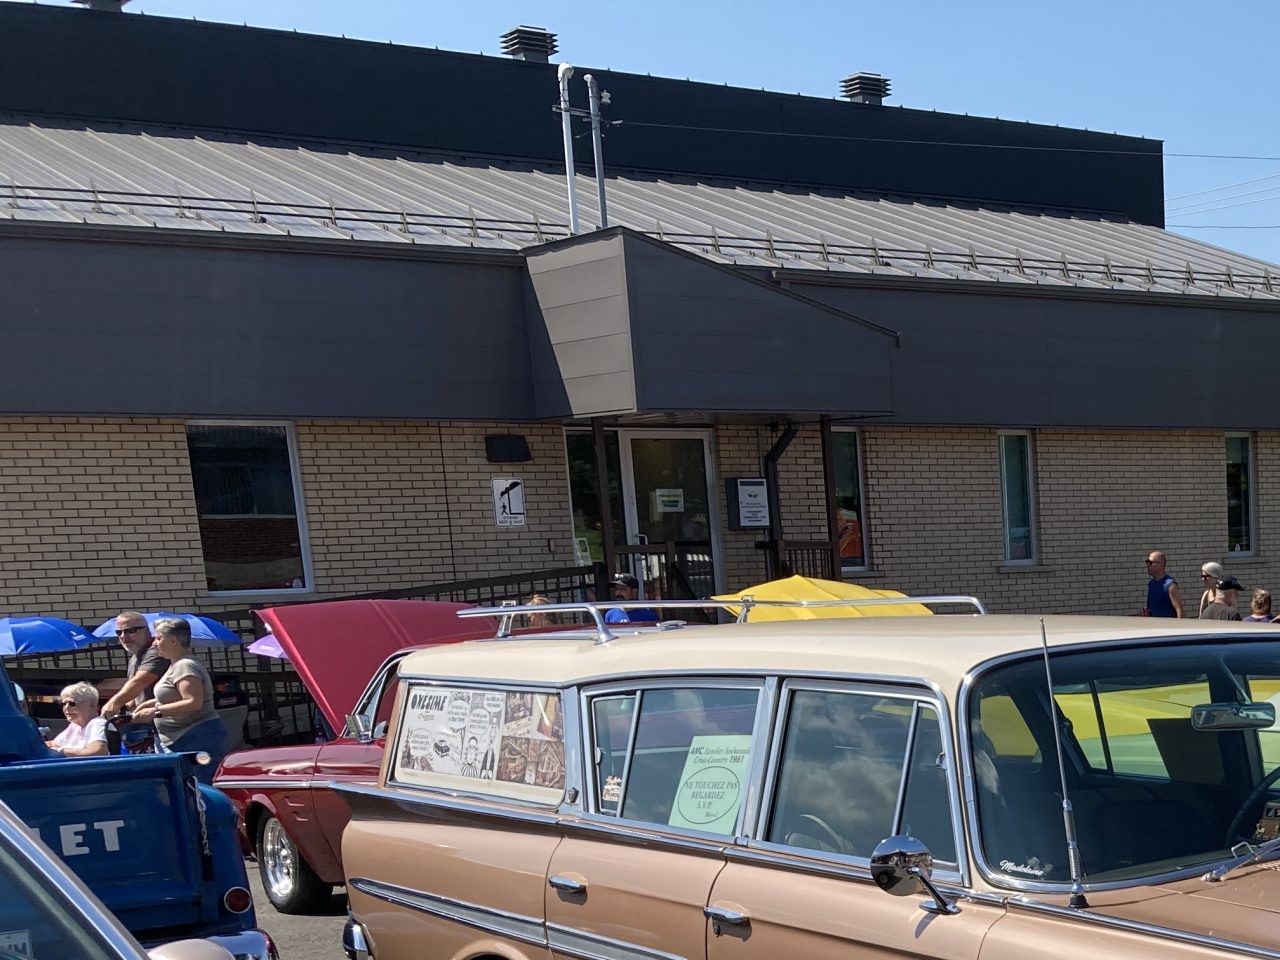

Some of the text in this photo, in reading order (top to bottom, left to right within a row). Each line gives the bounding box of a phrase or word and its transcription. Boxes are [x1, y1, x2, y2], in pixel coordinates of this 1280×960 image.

[690, 745, 705, 755] AMC
[729, 755, 744, 764] 1961
[694, 781, 726, 790] TOUCHEZ
[726, 781, 738, 790] PAS
[690, 791, 725, 800] REGARDEZ
